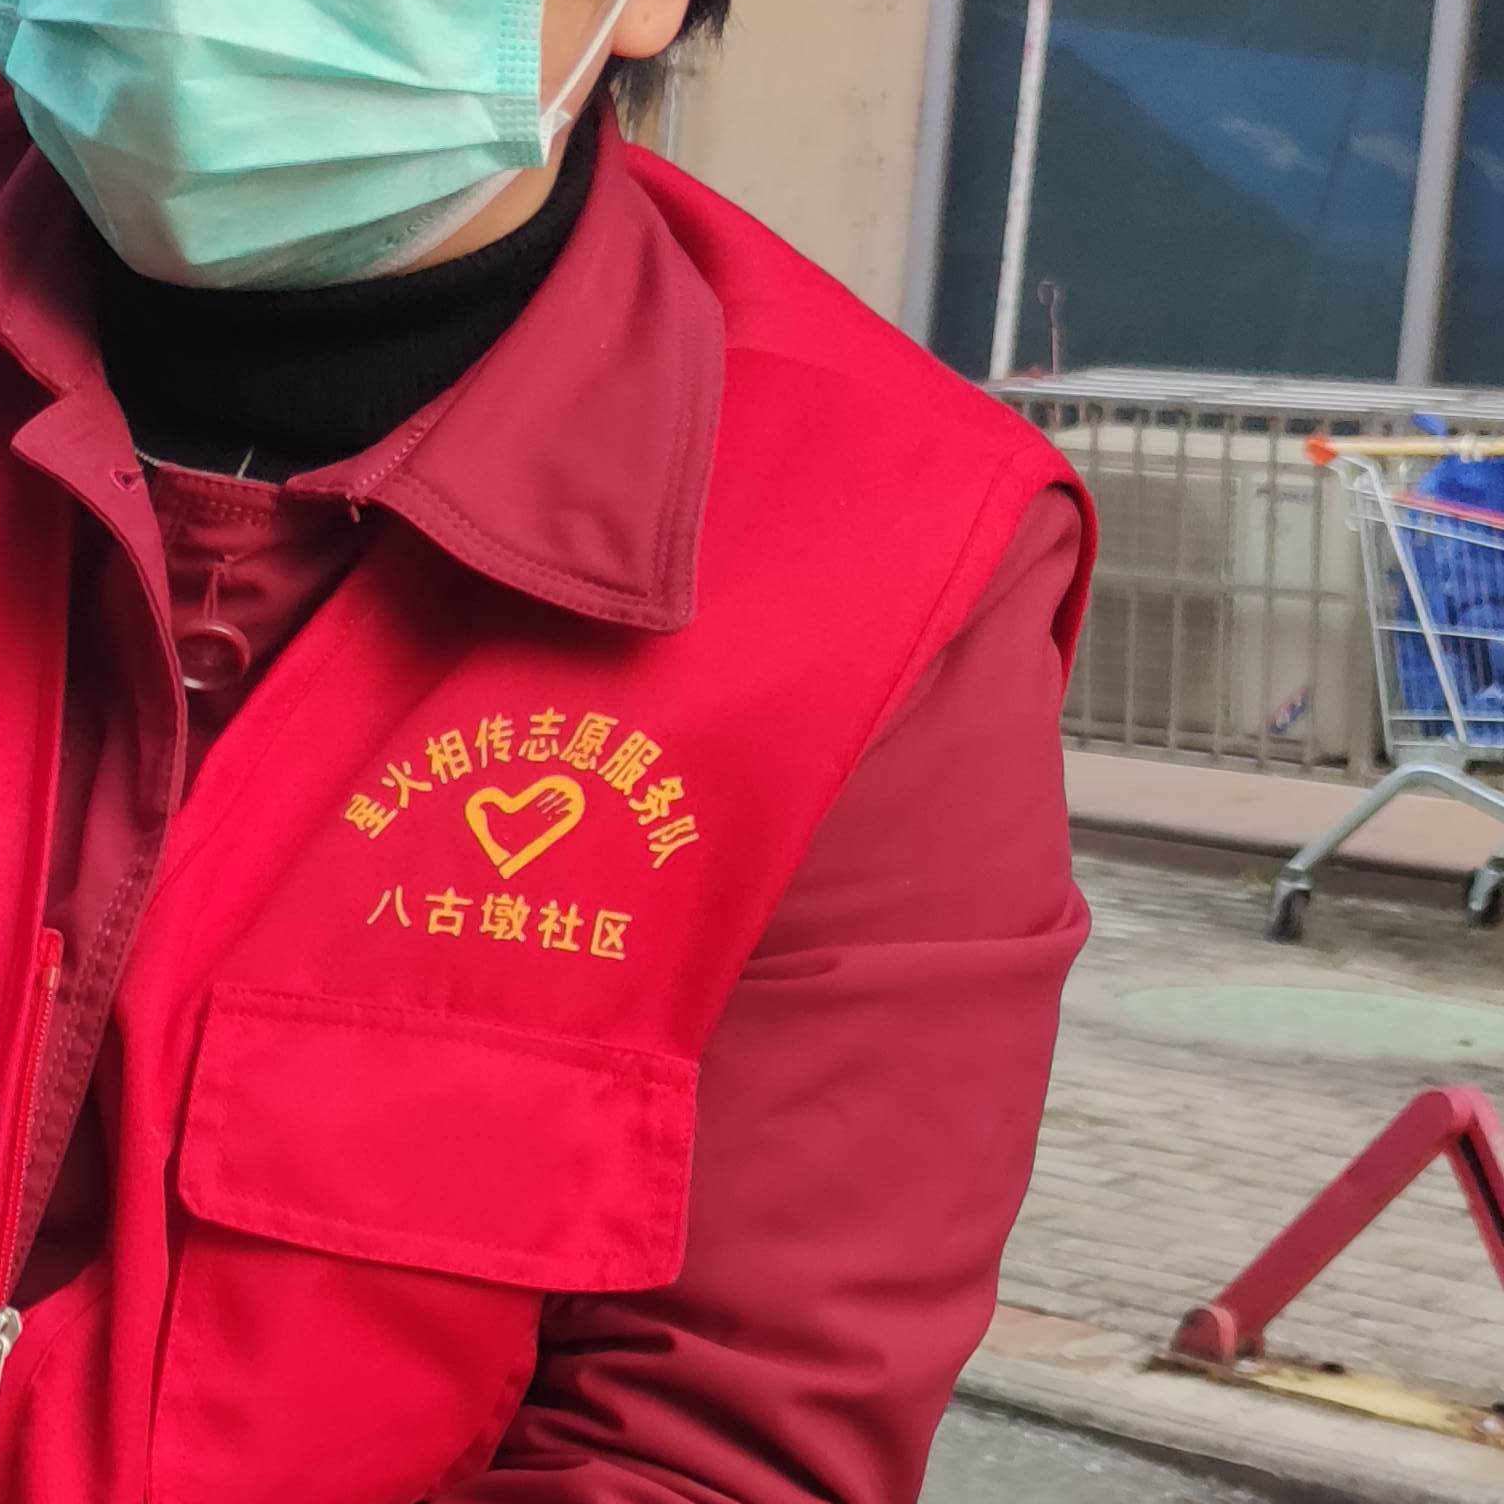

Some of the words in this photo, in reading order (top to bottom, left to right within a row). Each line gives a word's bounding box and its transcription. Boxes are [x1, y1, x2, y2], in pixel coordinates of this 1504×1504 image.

[343, 706, 700, 870] 星火相传志愿服务队
[367, 885, 633, 961] 八古墩社区
